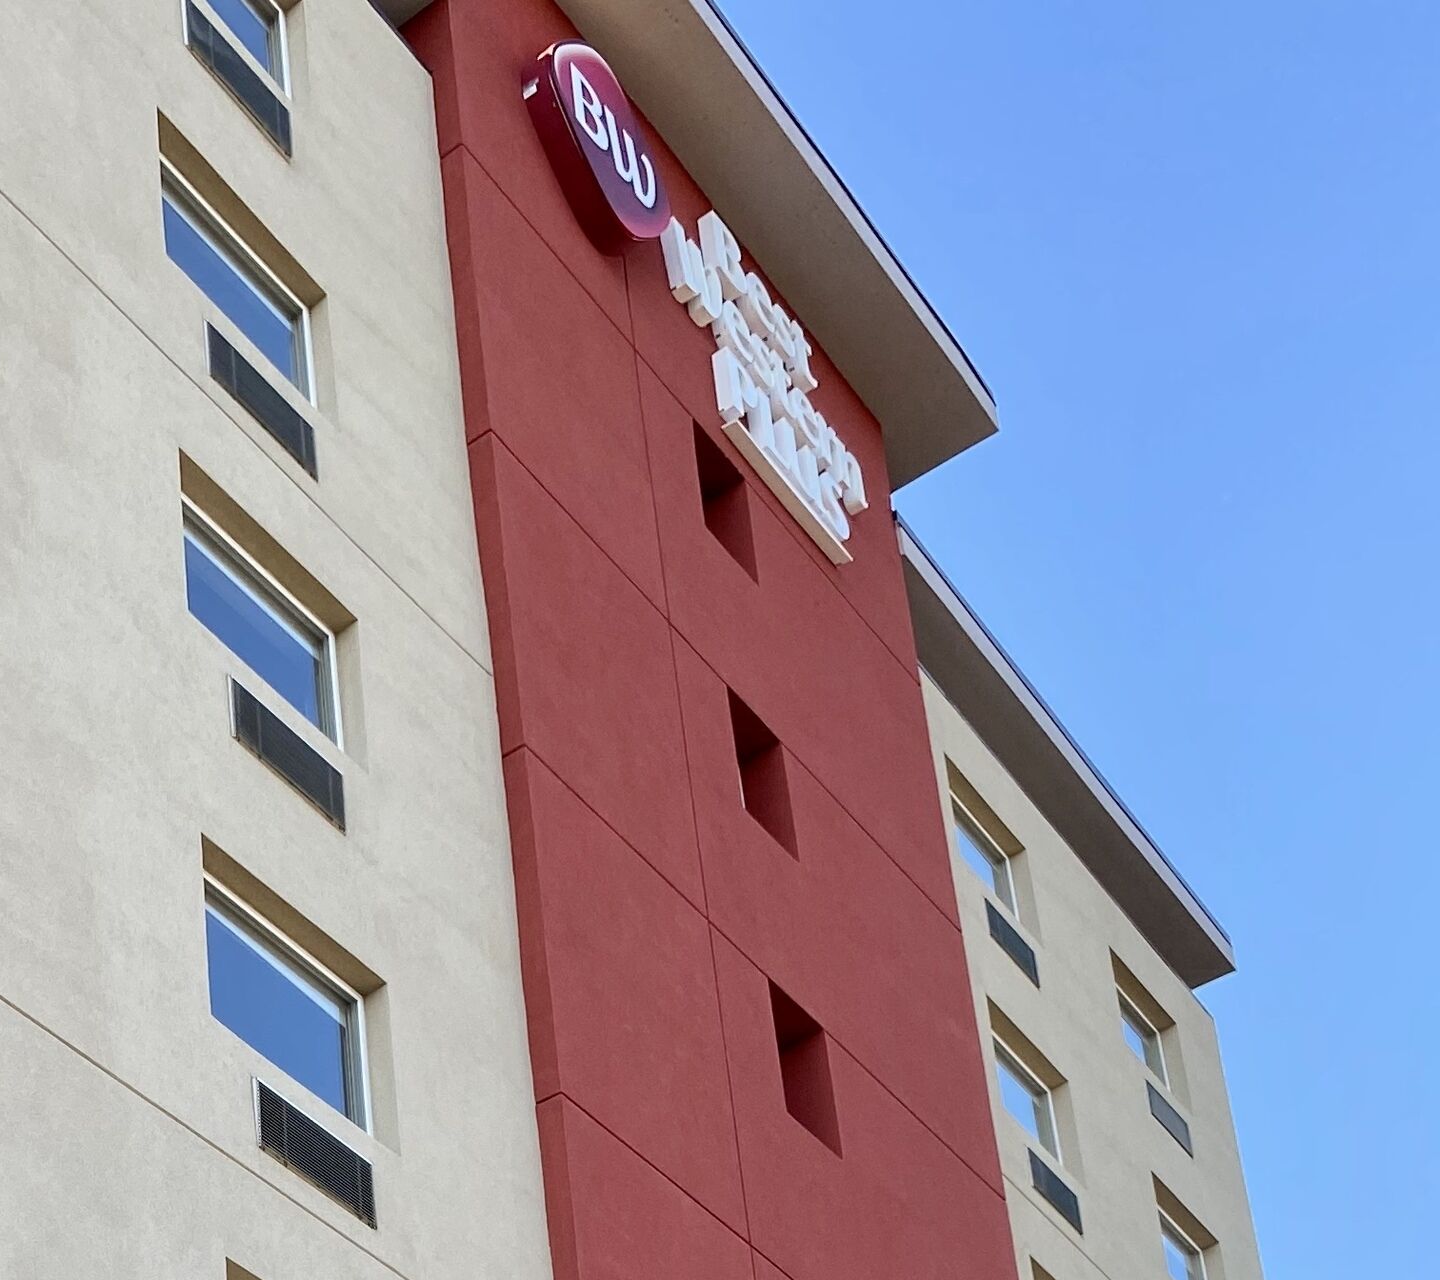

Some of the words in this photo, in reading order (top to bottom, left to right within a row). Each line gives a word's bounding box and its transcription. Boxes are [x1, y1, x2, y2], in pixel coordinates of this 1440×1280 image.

[570, 61, 657, 209] BW
[661, 216, 868, 515] Western
[698, 210, 818, 394] Best
[711, 346, 851, 541] Plus
